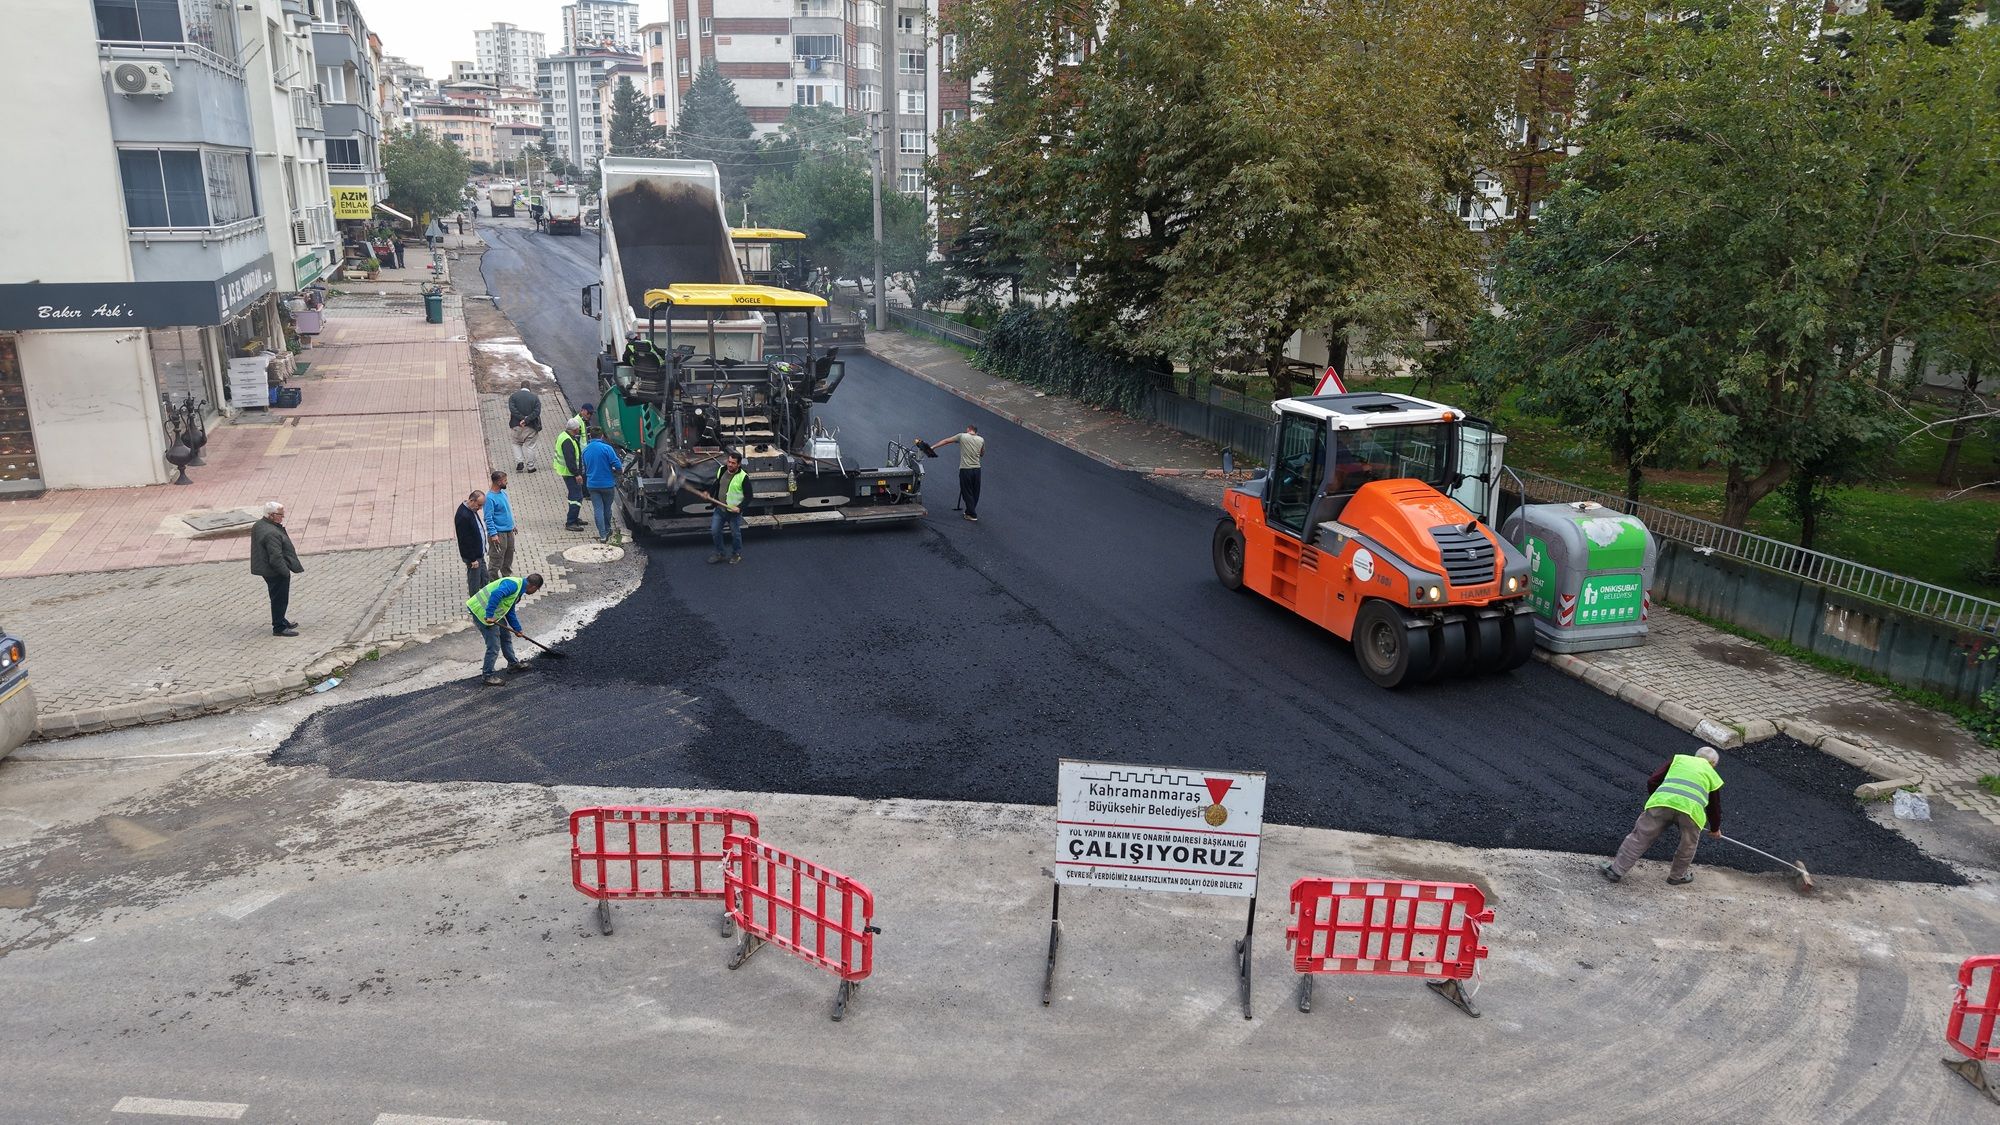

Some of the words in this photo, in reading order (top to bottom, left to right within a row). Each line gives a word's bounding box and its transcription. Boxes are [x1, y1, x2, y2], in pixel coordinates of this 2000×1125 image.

[735, 296, 761, 304] VÖGELE
[1460, 588, 1491, 600] HAMM
[1089, 783, 1201, 804] Kahramanmaraş
[1088, 801, 1146, 815] Büyükşehir
[1148, 804, 1201, 819] Belediyesi
[1084, 830, 1106, 838] YAPIM
[1107, 831, 1130, 840] BAKIM
[1132, 832, 1141, 840] VE
[1143, 833, 1171, 842] ONARIM
[1172, 834, 1201, 845] DAİRESİ
[1203, 837, 1247, 848] BAŞKANLIĞI
[1068, 839, 1244, 868] ÇALIŞIYORUZ
[1094, 872, 1128, 882] VERDİĞİMİZ
[1129, 874, 1178, 885] RAHATSIZLIKTAN
[1180, 877, 1201, 887] DOLAYI
[1202, 878, 1218, 888] ÖZÜR
[1220, 879, 1243, 890] DİLERİZ
